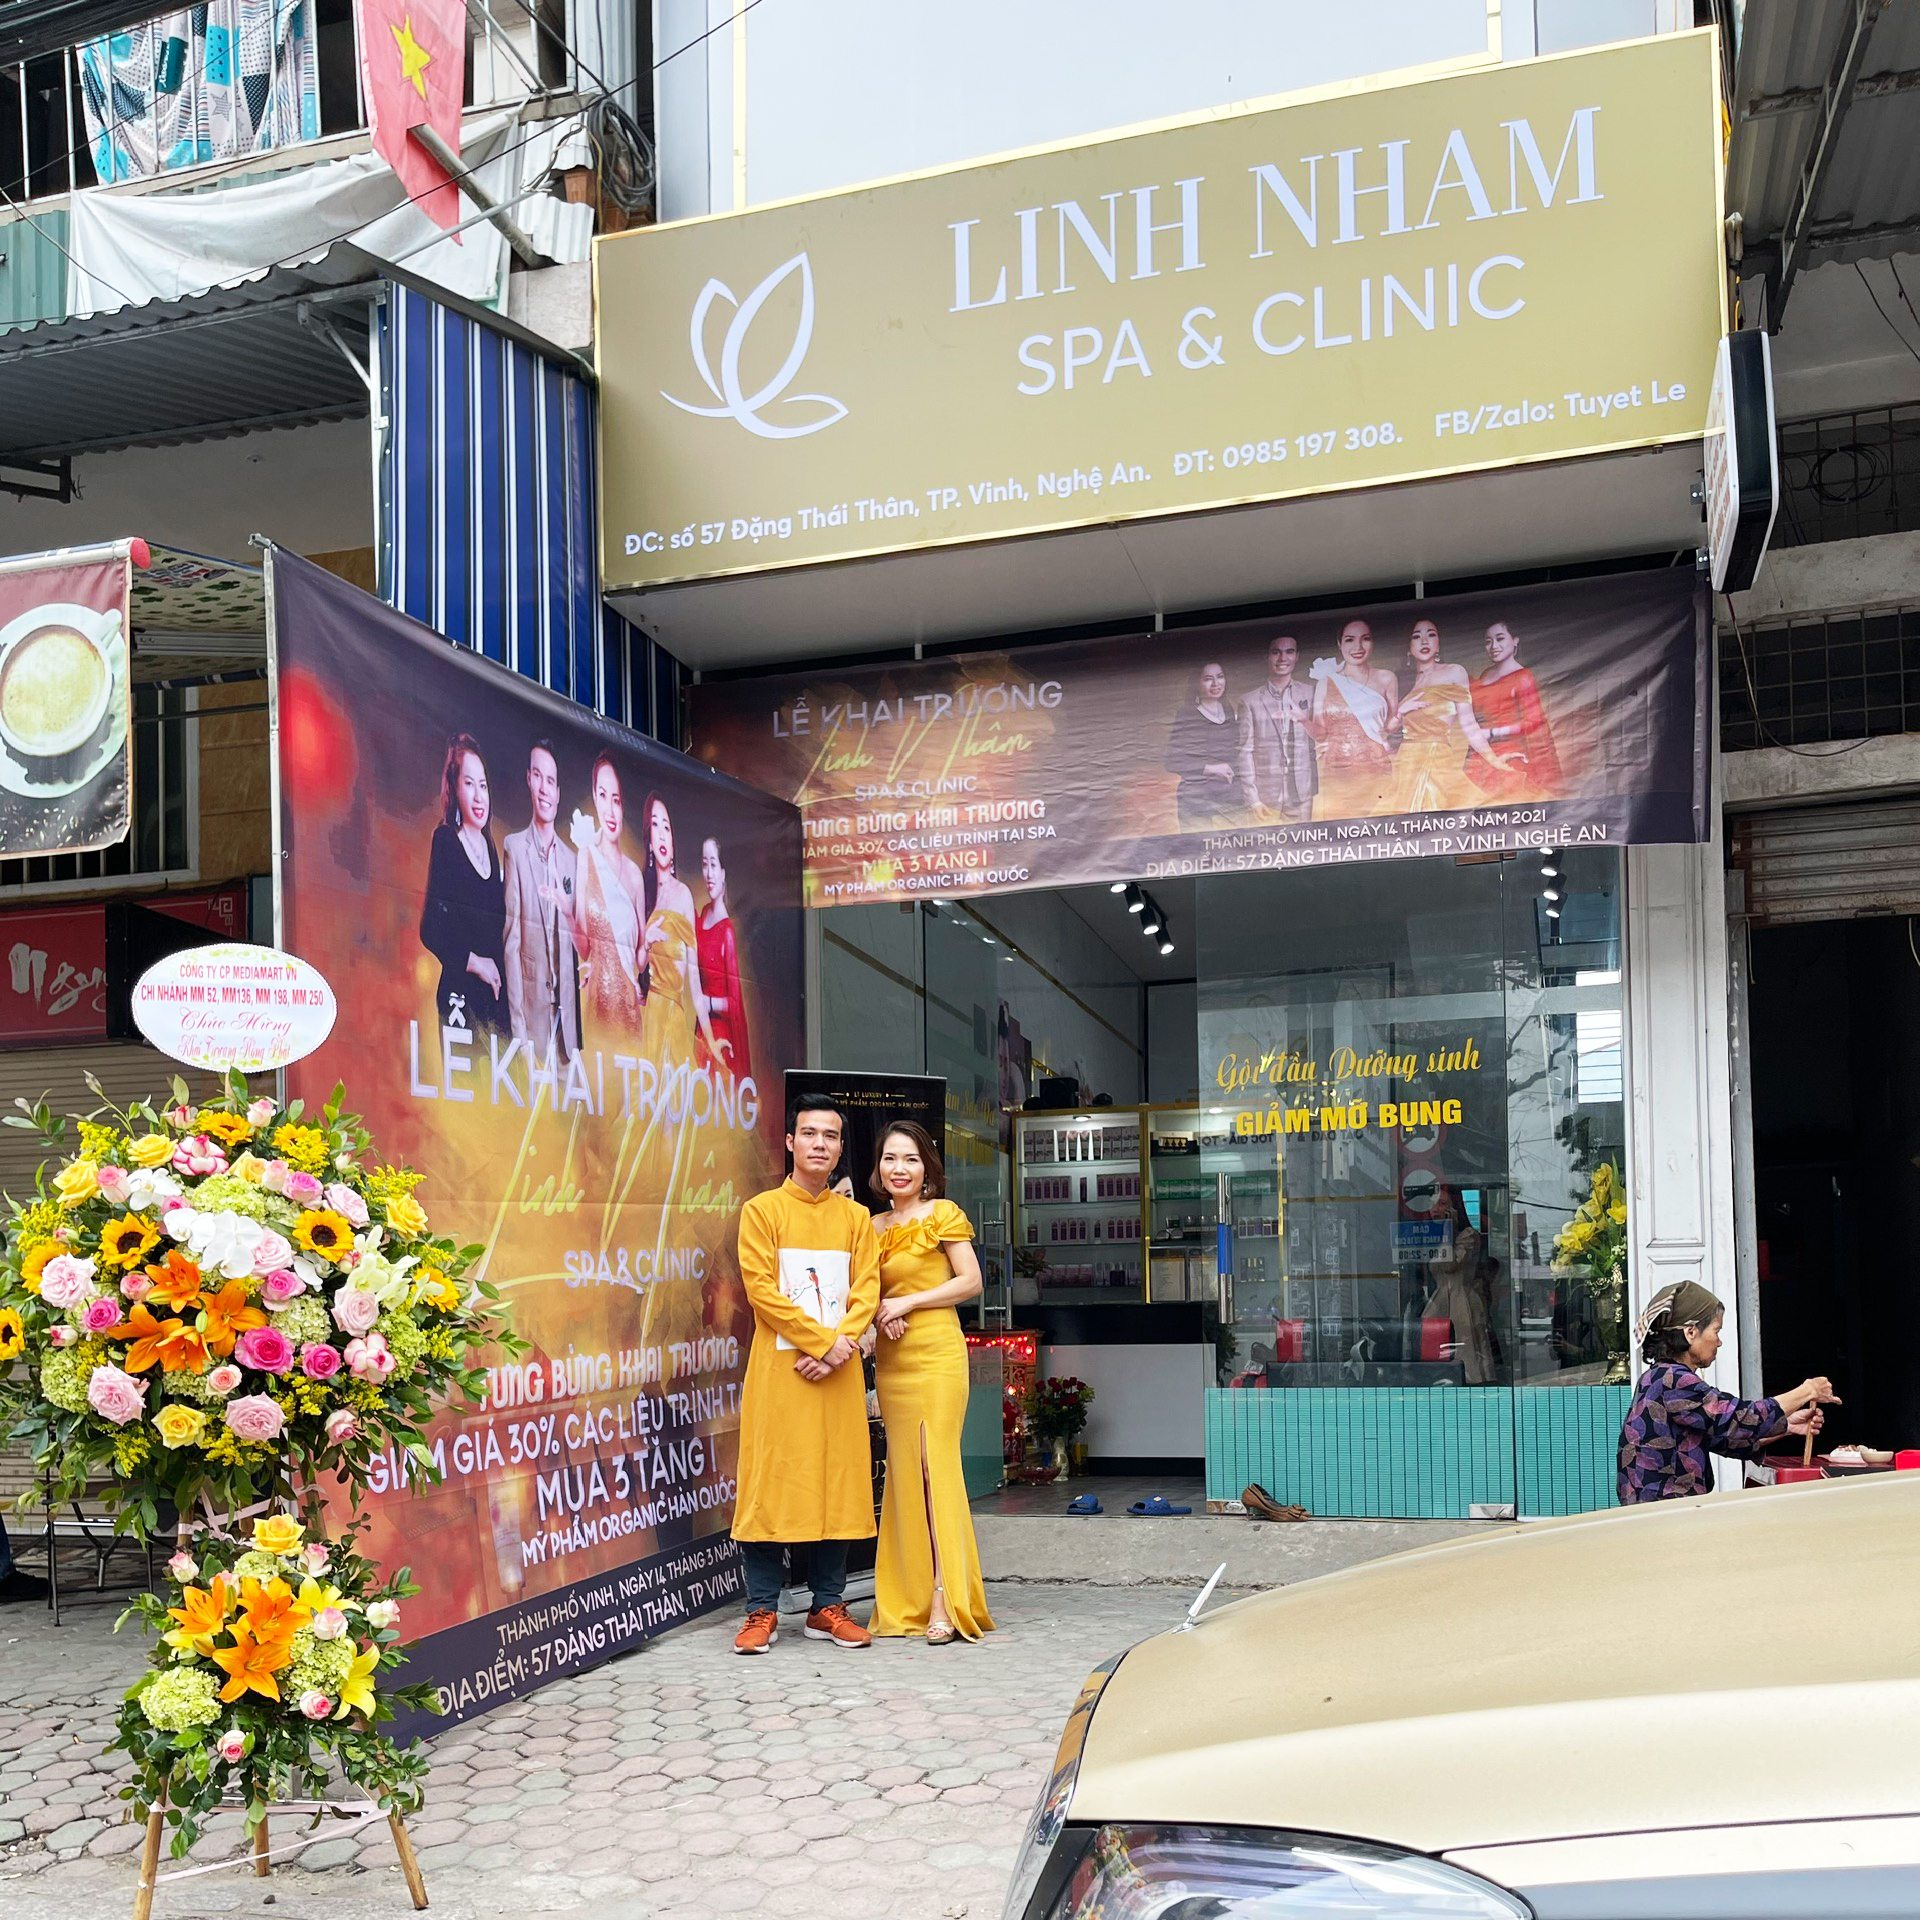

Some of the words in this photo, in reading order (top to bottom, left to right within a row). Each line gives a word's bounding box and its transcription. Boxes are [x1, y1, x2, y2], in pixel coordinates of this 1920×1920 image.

[947, 176, 1206, 313] LINH
[1248, 106, 1604, 259] NHAM
[1017, 320, 1152, 395] SPA
[1177, 306, 1225, 370] &
[1252, 254, 1526, 356] CLINIC
[624, 531, 664, 556] ĐC:
[670, 524, 695, 551] số
[700, 522, 725, 546] 57
[731, 513, 792, 546] Đặng
[798, 505, 849, 532] Thái
[854, 496, 920, 526] Thân,
[927, 487, 962, 512] TP.
[968, 480, 1030, 505] Vinh,
[1037, 467, 1103, 497] Nghệ
[1110, 461, 1152, 485] An.
[1173, 448, 1216, 477] ĐT:
[1222, 438, 1288, 469] 0985
[1294, 431, 1336, 459] 197
[1344, 422, 1403, 450] 308.
[1434, 401, 1555, 439] FB/Zalo:
[1563, 382, 1642, 421] Tuyet
[1650, 381, 1687, 405] Le
[773, 697, 811, 738] LỄ
[821, 697, 904, 733] KHAI
[913, 680, 1063, 723] TRƯƠNG
[803, 843, 828, 859] IẢM
[857, 838, 886, 855] 30%
[887, 835, 919, 852] CÁC
[921, 832, 953, 851] LIỆU
[956, 828, 999, 846] TRÌNH
[1001, 827, 1025, 845] TẠI
[1027, 825, 1057, 840] SPA
[915, 807, 958, 830] KHAI
[1203, 833, 1254, 851] THÀNH
[1257, 827, 1288, 846] PHỐ
[1290, 828, 1334, 843] VINH,
[1336, 820, 1381, 840] NGÀY
[1401, 815, 1457, 834] THÁNG
[1458, 815, 1468, 829] 3
[1471, 810, 1509, 828] NĂM
[909, 855, 920, 873] 3
[1236, 854, 1257, 870] 57
[1259, 848, 1314, 871] ĐẶNG
[1318, 841, 1363, 862] THÁI
[1366, 838, 1426, 859] THÂN,
[1430, 836, 1452, 853] TP
[1456, 832, 1506, 851] VINH
[1514, 823, 1572, 848] NGHỆ
[1576, 823, 1607, 842] AN
[824, 882, 845, 897] MỸ
[887, 874, 951, 892] ORGANIC
[986, 864, 1029, 885] QUỐC
[141, 984, 156, 1001] CHI
[157, 981, 188, 1002] NHÁNH
[190, 986, 205, 1003] MM
[207, 987, 220, 1006] 52,
[222, 987, 254, 1006] MM136,
[255, 988, 271, 1004] MM
[273, 989, 290, 1007] 198,
[292, 989, 307, 1006] MM
[309, 990, 324, 1006] 250
[180, 961, 204, 978] CÔNG
[207, 966, 218, 978] TY
[219, 966, 231, 979] CP
[232, 966, 283, 981] MEDIAMART
[286, 967, 298, 981] VN
[180, 1007, 226, 1030] Chúc
[229, 1010, 294, 1037] Mừng
[410, 992, 475, 1103] LỄ
[490, 1033, 604, 1117] KHAI
[614, 1053, 758, 1132] TRƯƠNG
[1328, 1046, 1418, 1083] Dưỡng
[1426, 1037, 1482, 1073] sinh
[1235, 1101, 1310, 1136] GIẢM
[1320, 1098, 1369, 1132] MỠ
[1378, 1098, 1463, 1133] BỤNG
[618, 1345, 663, 1388] KHAI
[453, 1417, 506, 1475] GIÁ
[508, 1413, 561, 1465] 30%
[564, 1400, 615, 1450] CÁC
[617, 1391, 664, 1446] LIỆU
[667, 1381, 725, 1428] TRÌNH
[536, 1461, 610, 1522] MUA
[612, 1453, 630, 1500] 3
[521, 1530, 548, 1568] MỸ
[549, 1514, 599, 1559] PHẨM
[599, 1500, 668, 1542] ORGANIC
[668, 1486, 699, 1521] HÀN
[699, 1474, 737, 1510] QUỐC
[496, 1609, 550, 1646] THÀNH
[551, 1589, 579, 1626] PHỐ
[579, 1584, 619, 1614] VINH,
[618, 1566, 655, 1600] NGÀY
[666, 1551, 706, 1581] THÁNG
[707, 1548, 714, 1566] 3
[714, 1538, 739, 1562] NĂM
[437, 1678, 477, 1719] ĐỊA
[531, 1642, 552, 1677] 57
[554, 1623, 607, 1667] ĐẶNG
[605, 1601, 644, 1644] THÁI
[643, 1590, 690, 1628] THÂN,
[688, 1583, 704, 1609] TP
[704, 1570, 739, 1600] VINH
